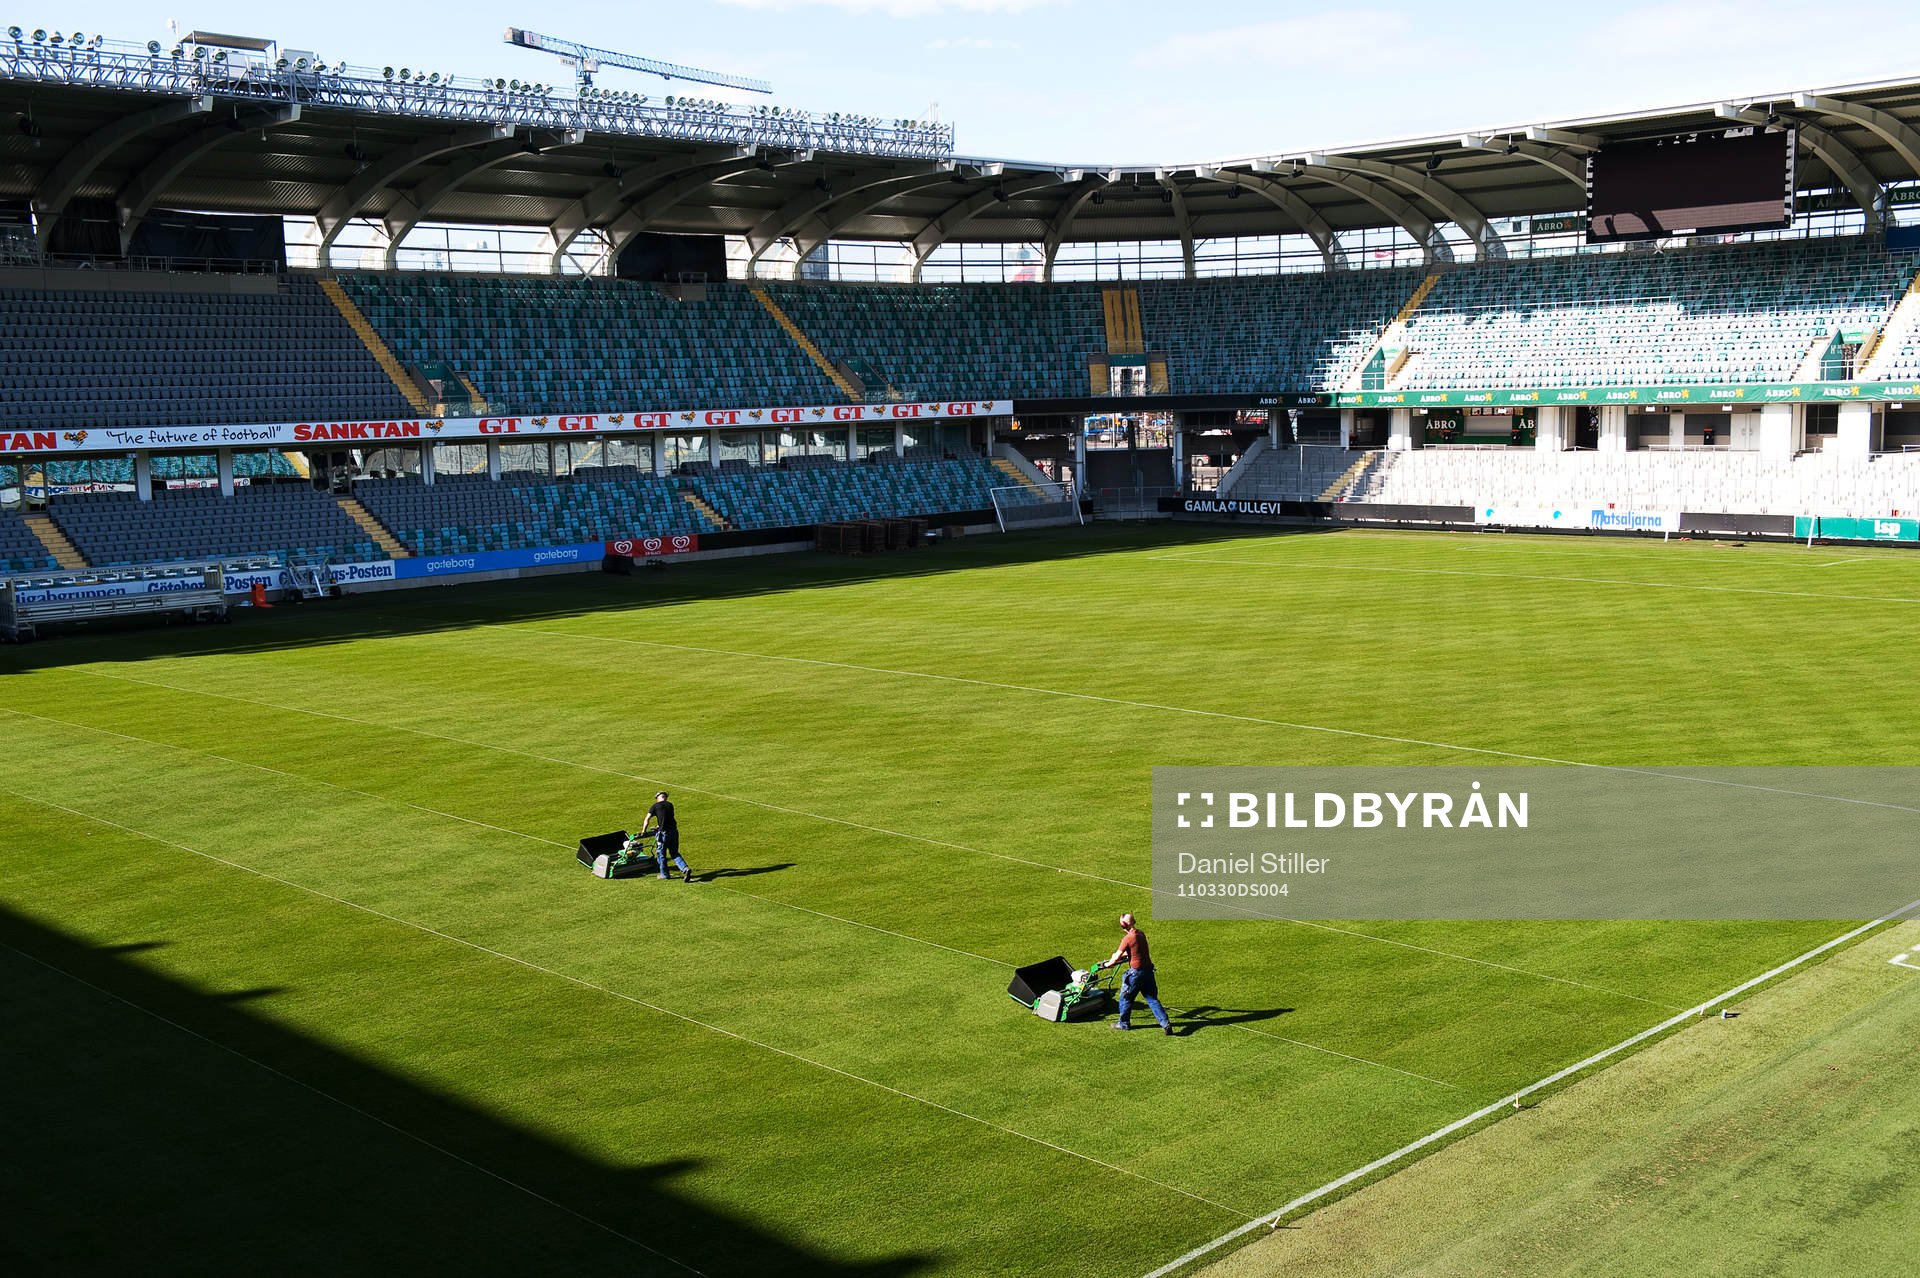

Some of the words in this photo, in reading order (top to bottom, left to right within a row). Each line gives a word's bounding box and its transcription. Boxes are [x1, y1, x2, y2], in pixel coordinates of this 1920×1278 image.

[770, 408, 805, 423] GT
[833, 406, 866, 420] GT
[892, 404, 923, 418] GT
[947, 402, 977, 416] GT
[558, 415, 599, 431] GT
[633, 412, 672, 428] GT
[704, 410, 741, 425] GT
[1425, 418, 1457, 430] ÅBRO
[293, 421, 420, 441] SANKTAN
[478, 417, 522, 434] GT
[148, 430, 198, 443] future
[202, 428, 217, 441] of
[1184, 500, 1227, 513] GAMLA
[1239, 501, 1281, 515] ULLEVI
